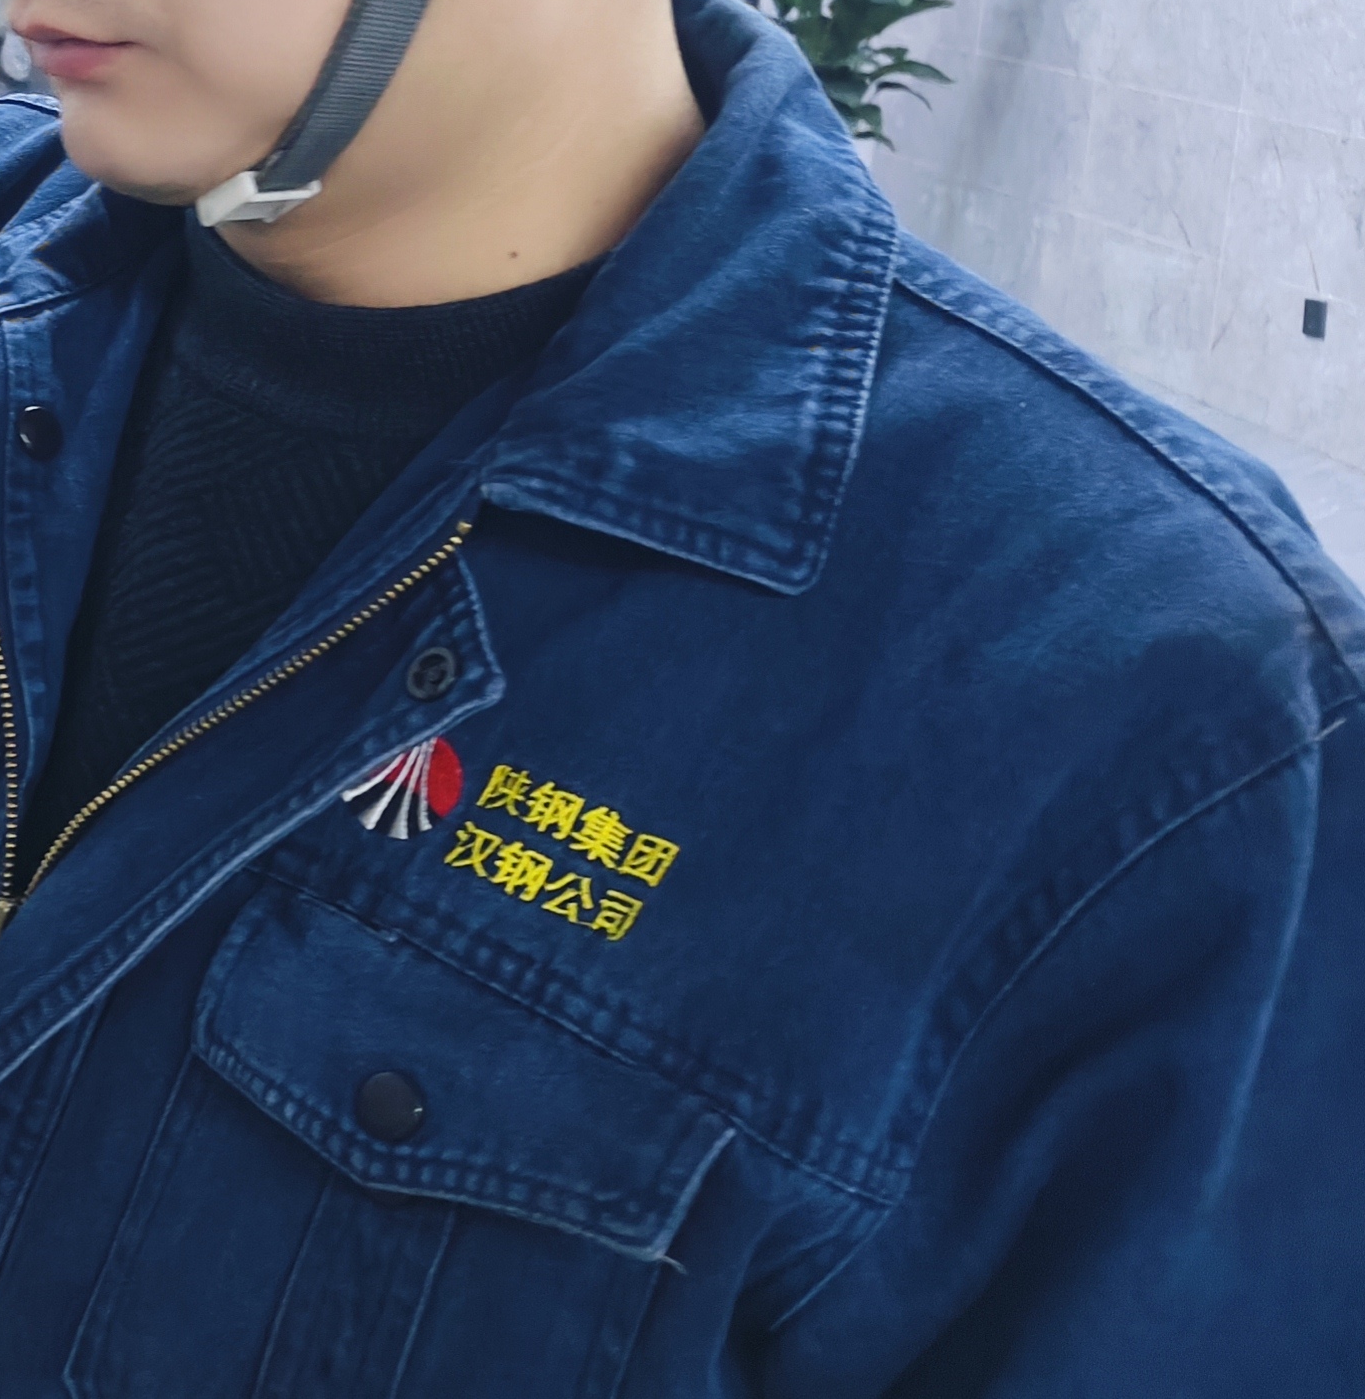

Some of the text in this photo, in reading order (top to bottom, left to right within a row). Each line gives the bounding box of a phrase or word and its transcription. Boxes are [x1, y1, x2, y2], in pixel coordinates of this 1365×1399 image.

[444, 820, 645, 942] 汉钢公司
[476, 764, 681, 888] 陕钢集团
